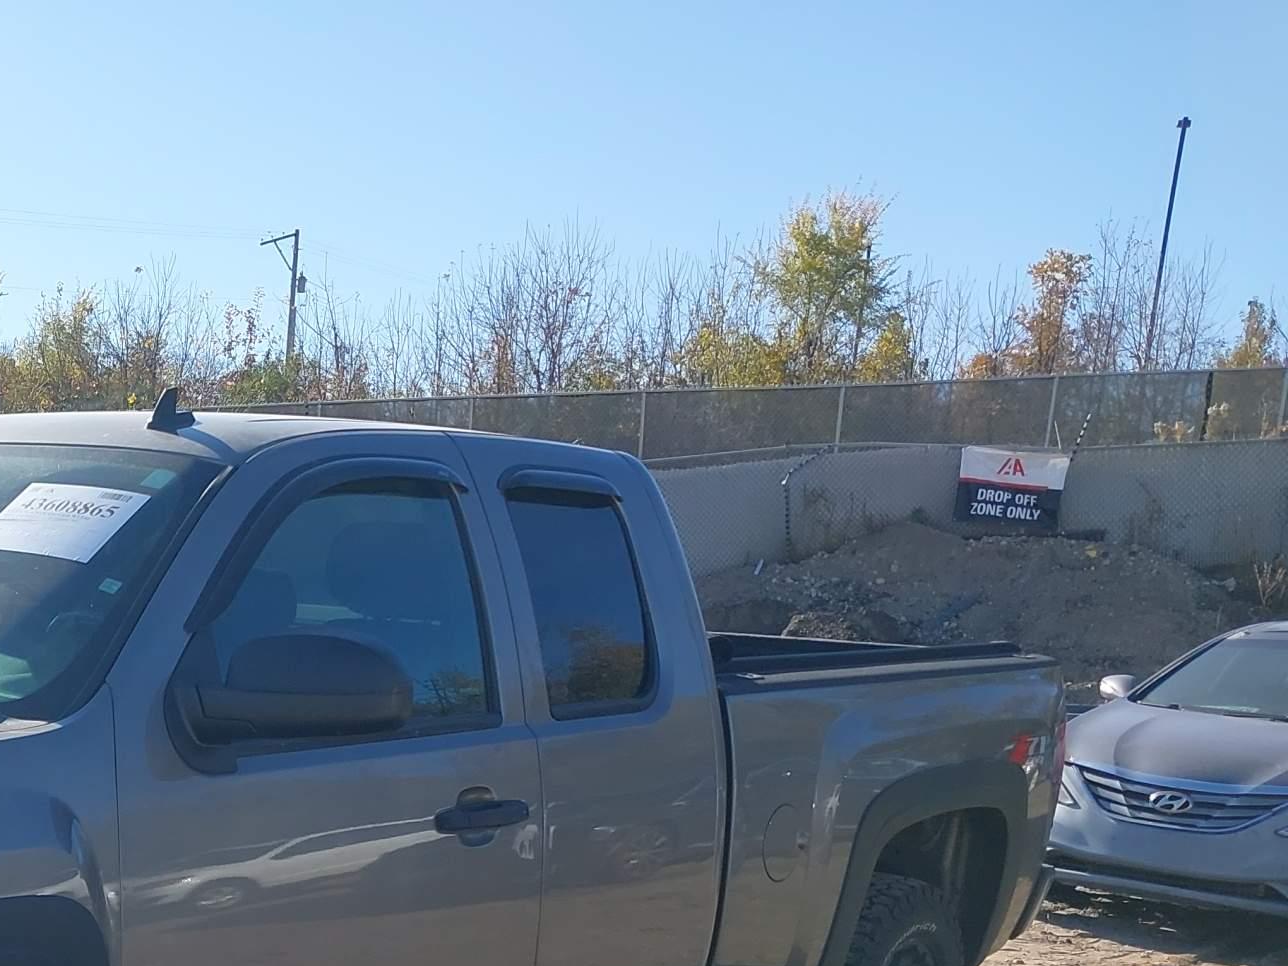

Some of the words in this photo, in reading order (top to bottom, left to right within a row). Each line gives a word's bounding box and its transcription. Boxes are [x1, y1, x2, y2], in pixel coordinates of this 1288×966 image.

[976, 488, 1012, 504] DROP
[1015, 493, 1038, 507] OFF
[21, 497, 121, 519] 43608865
[969, 502, 1004, 517] ZONE
[1006, 506, 1041, 521] ONLY
